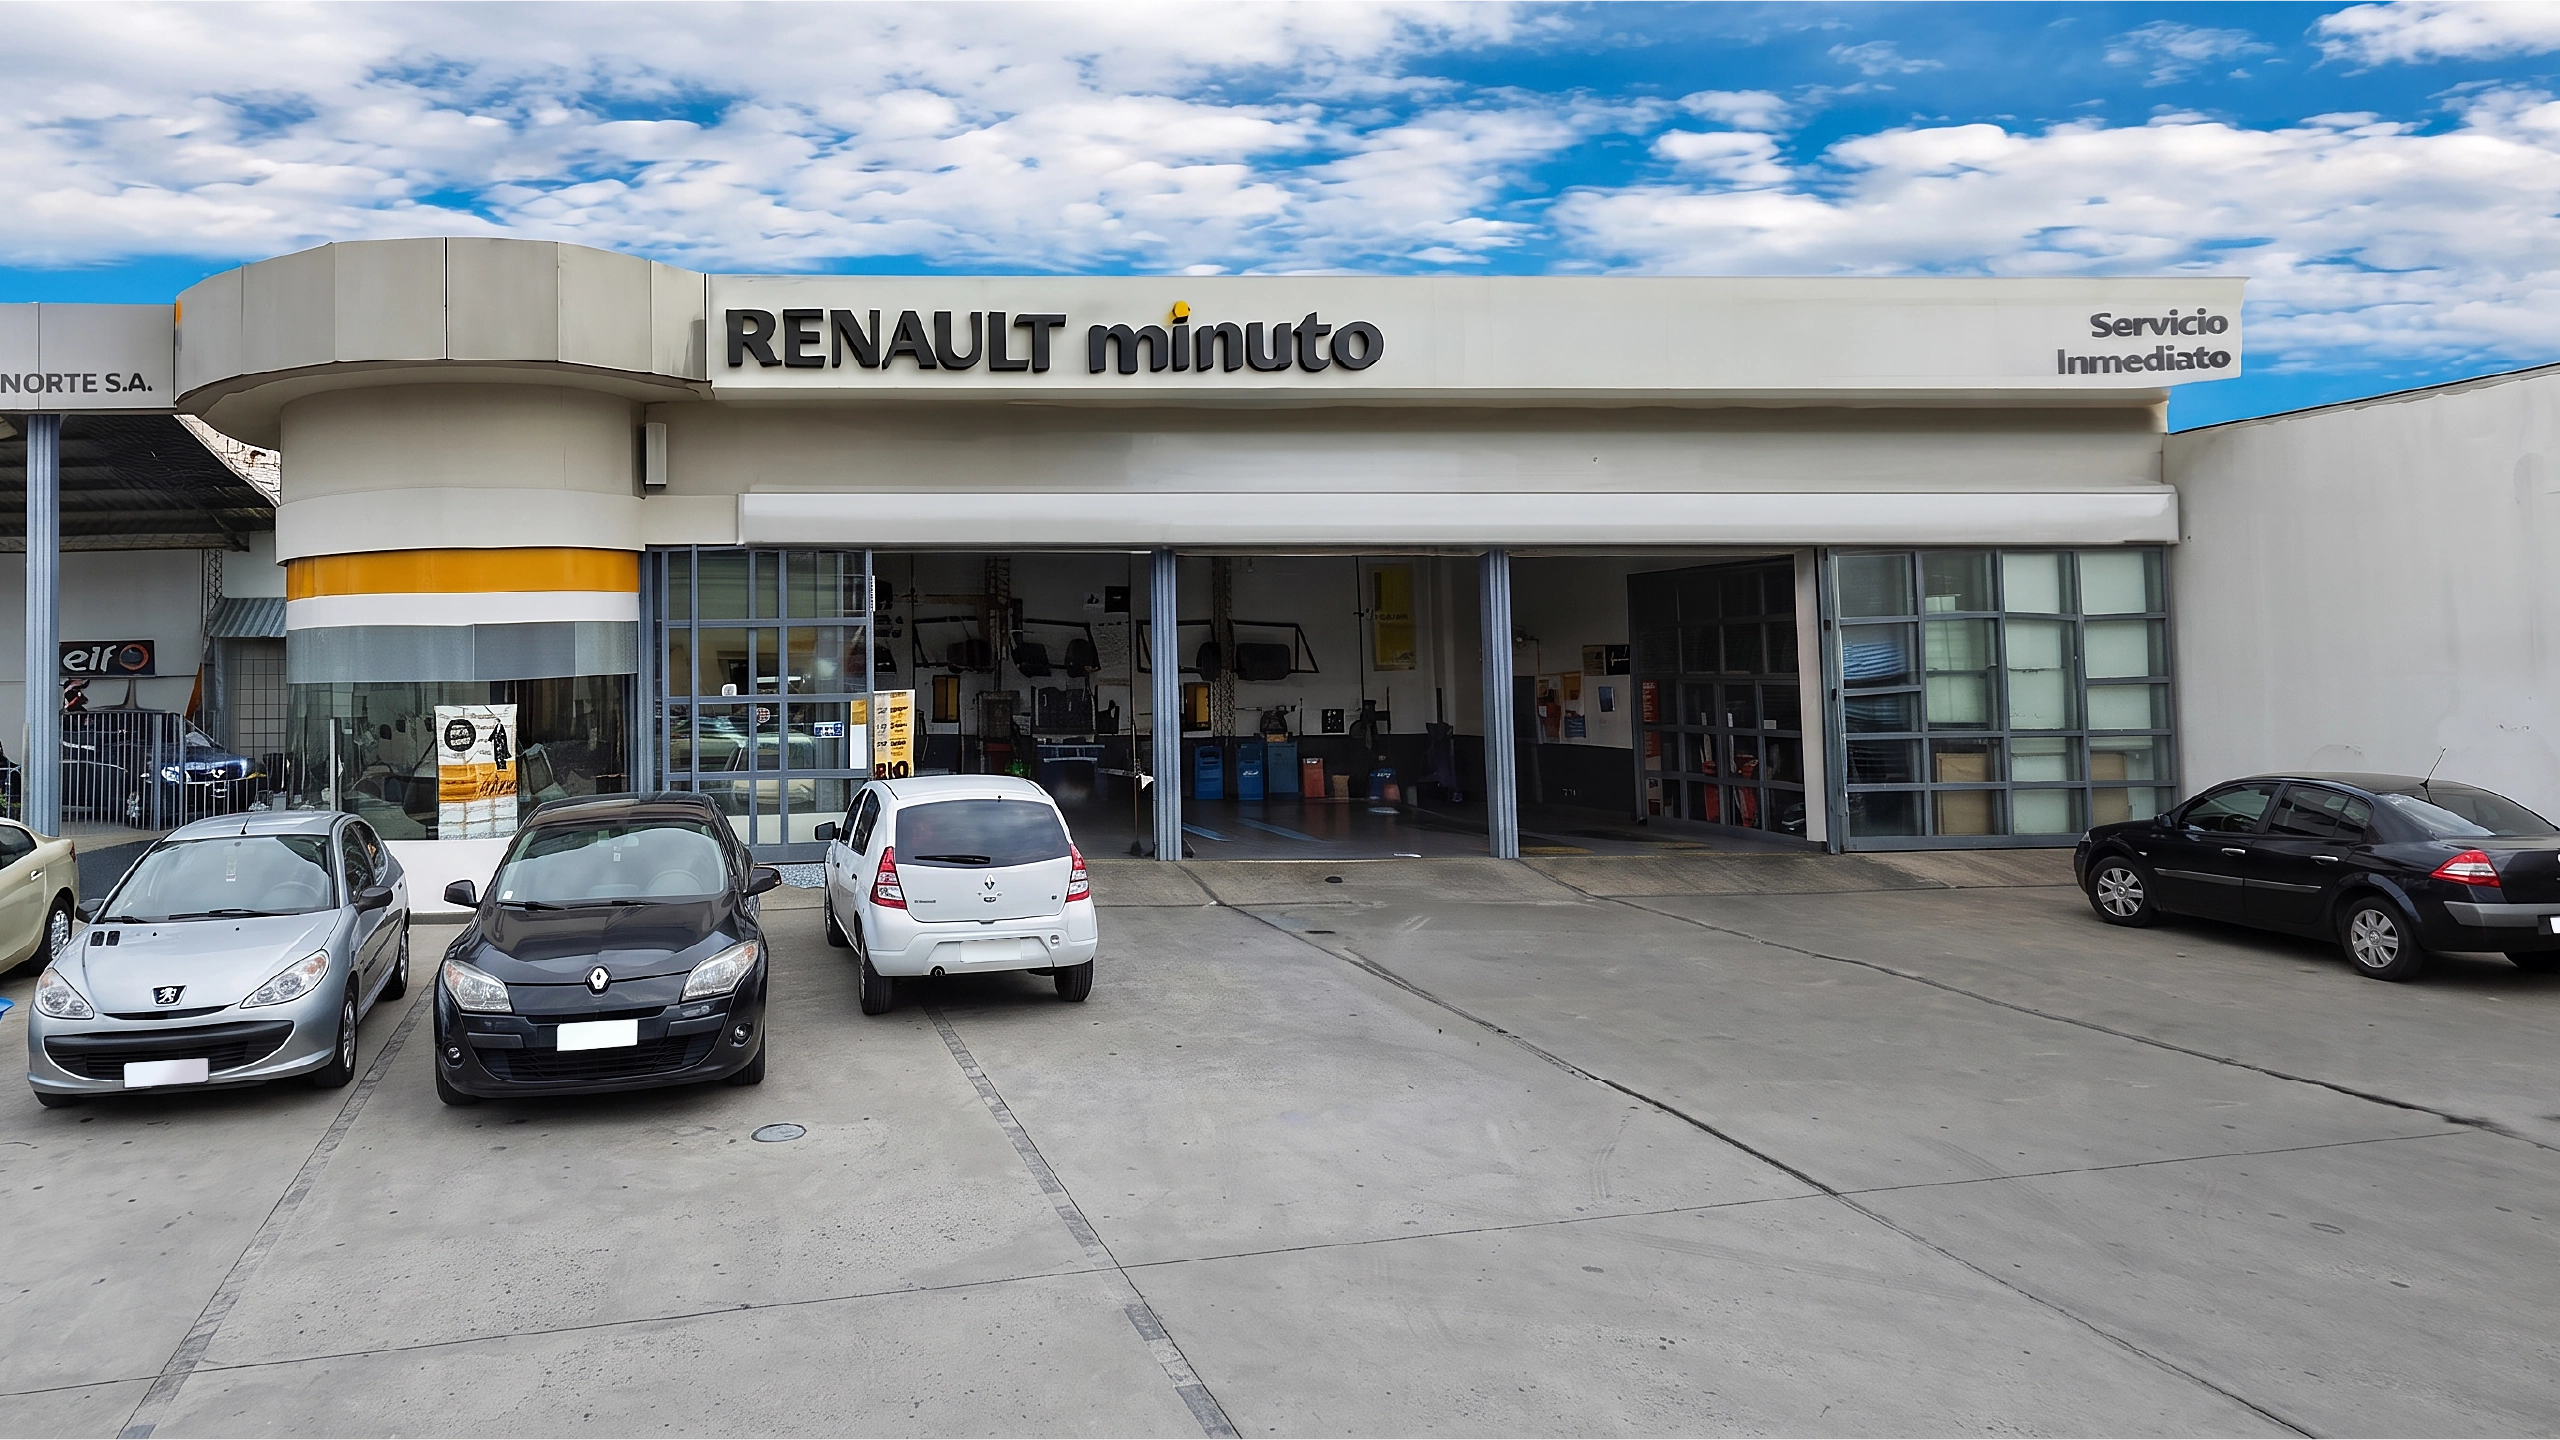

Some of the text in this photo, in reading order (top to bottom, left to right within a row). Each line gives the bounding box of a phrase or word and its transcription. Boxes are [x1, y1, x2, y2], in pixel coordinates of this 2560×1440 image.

[725, 300, 1385, 376] RENAULT minuto
[2090, 307, 2229, 338] Servicio
[2057, 344, 2231, 375] Inmediato
[0, 372, 153, 393] NORTE S.A.
[62, 644, 117, 672] elf
